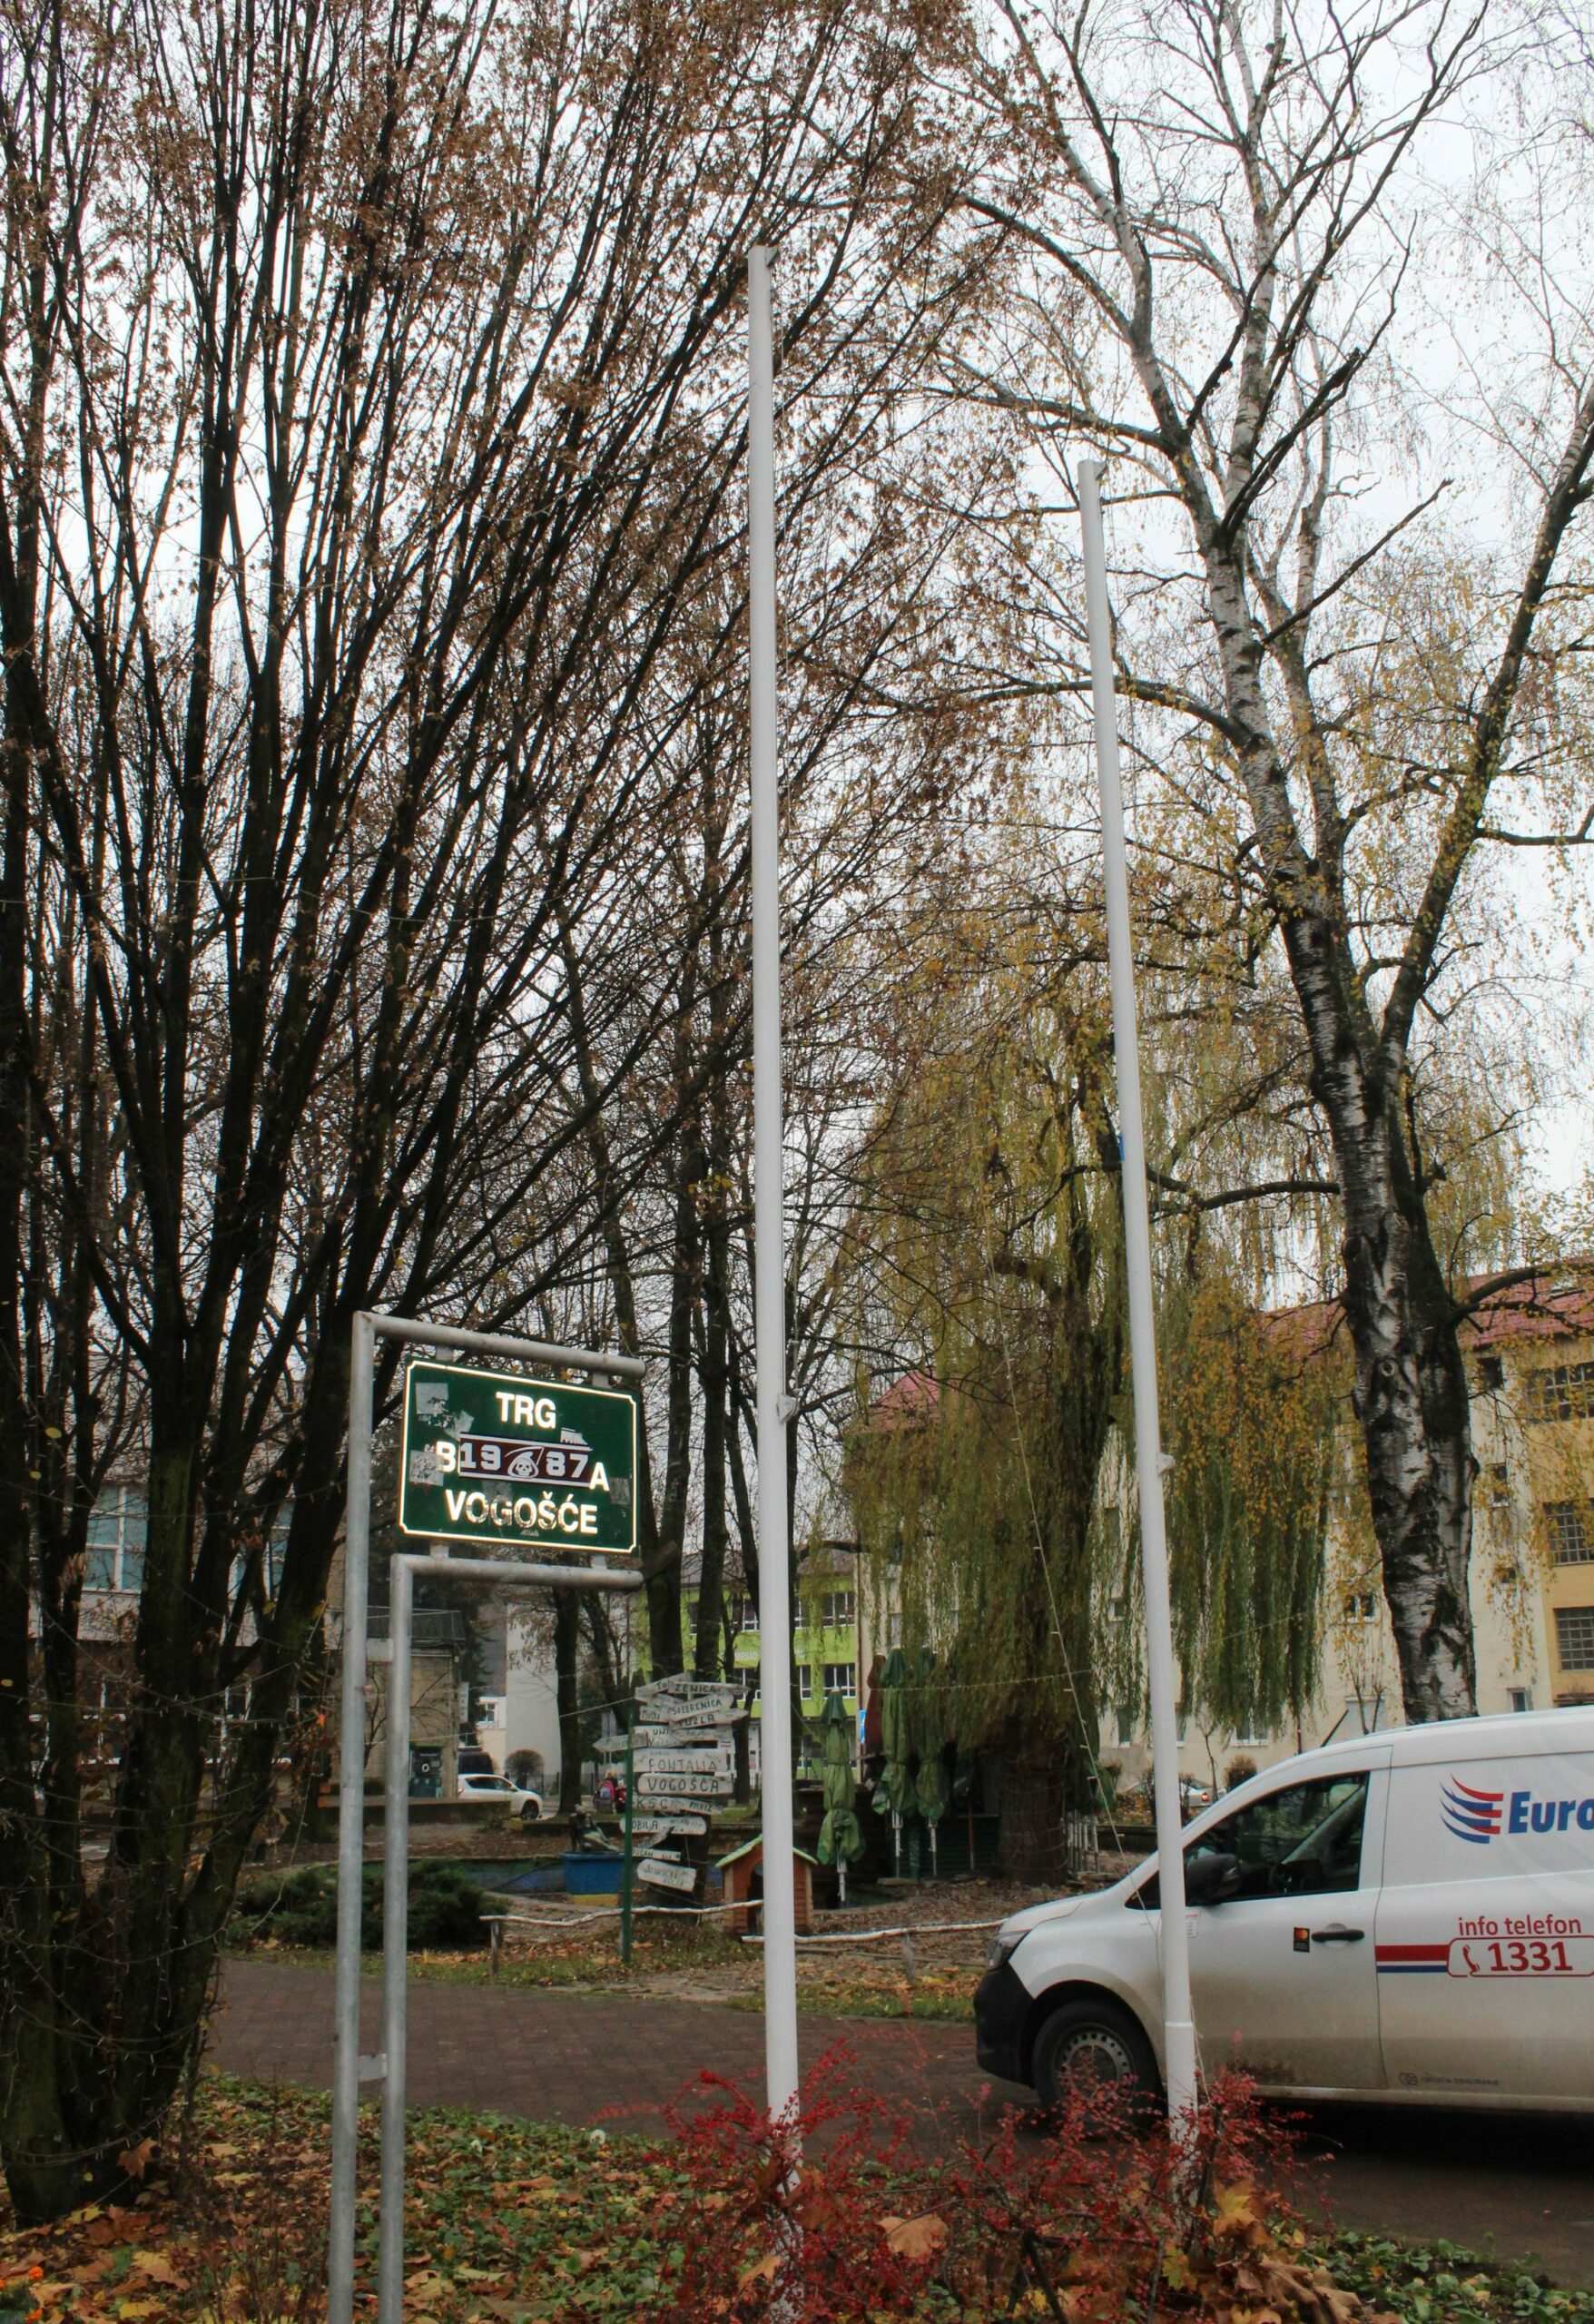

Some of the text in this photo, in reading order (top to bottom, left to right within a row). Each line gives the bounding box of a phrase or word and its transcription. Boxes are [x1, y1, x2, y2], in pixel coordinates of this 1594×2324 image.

[496, 1392, 556, 1429] TRG
[460, 1442, 502, 1471] 19
[546, 1451, 589, 1478] 87
[445, 1489, 598, 1534] VOGOŠĆE
[674, 1683, 717, 1693] ZENICA
[1459, 1914, 1582, 1936] info telefon
[1487, 1941, 1573, 1973] 1331
